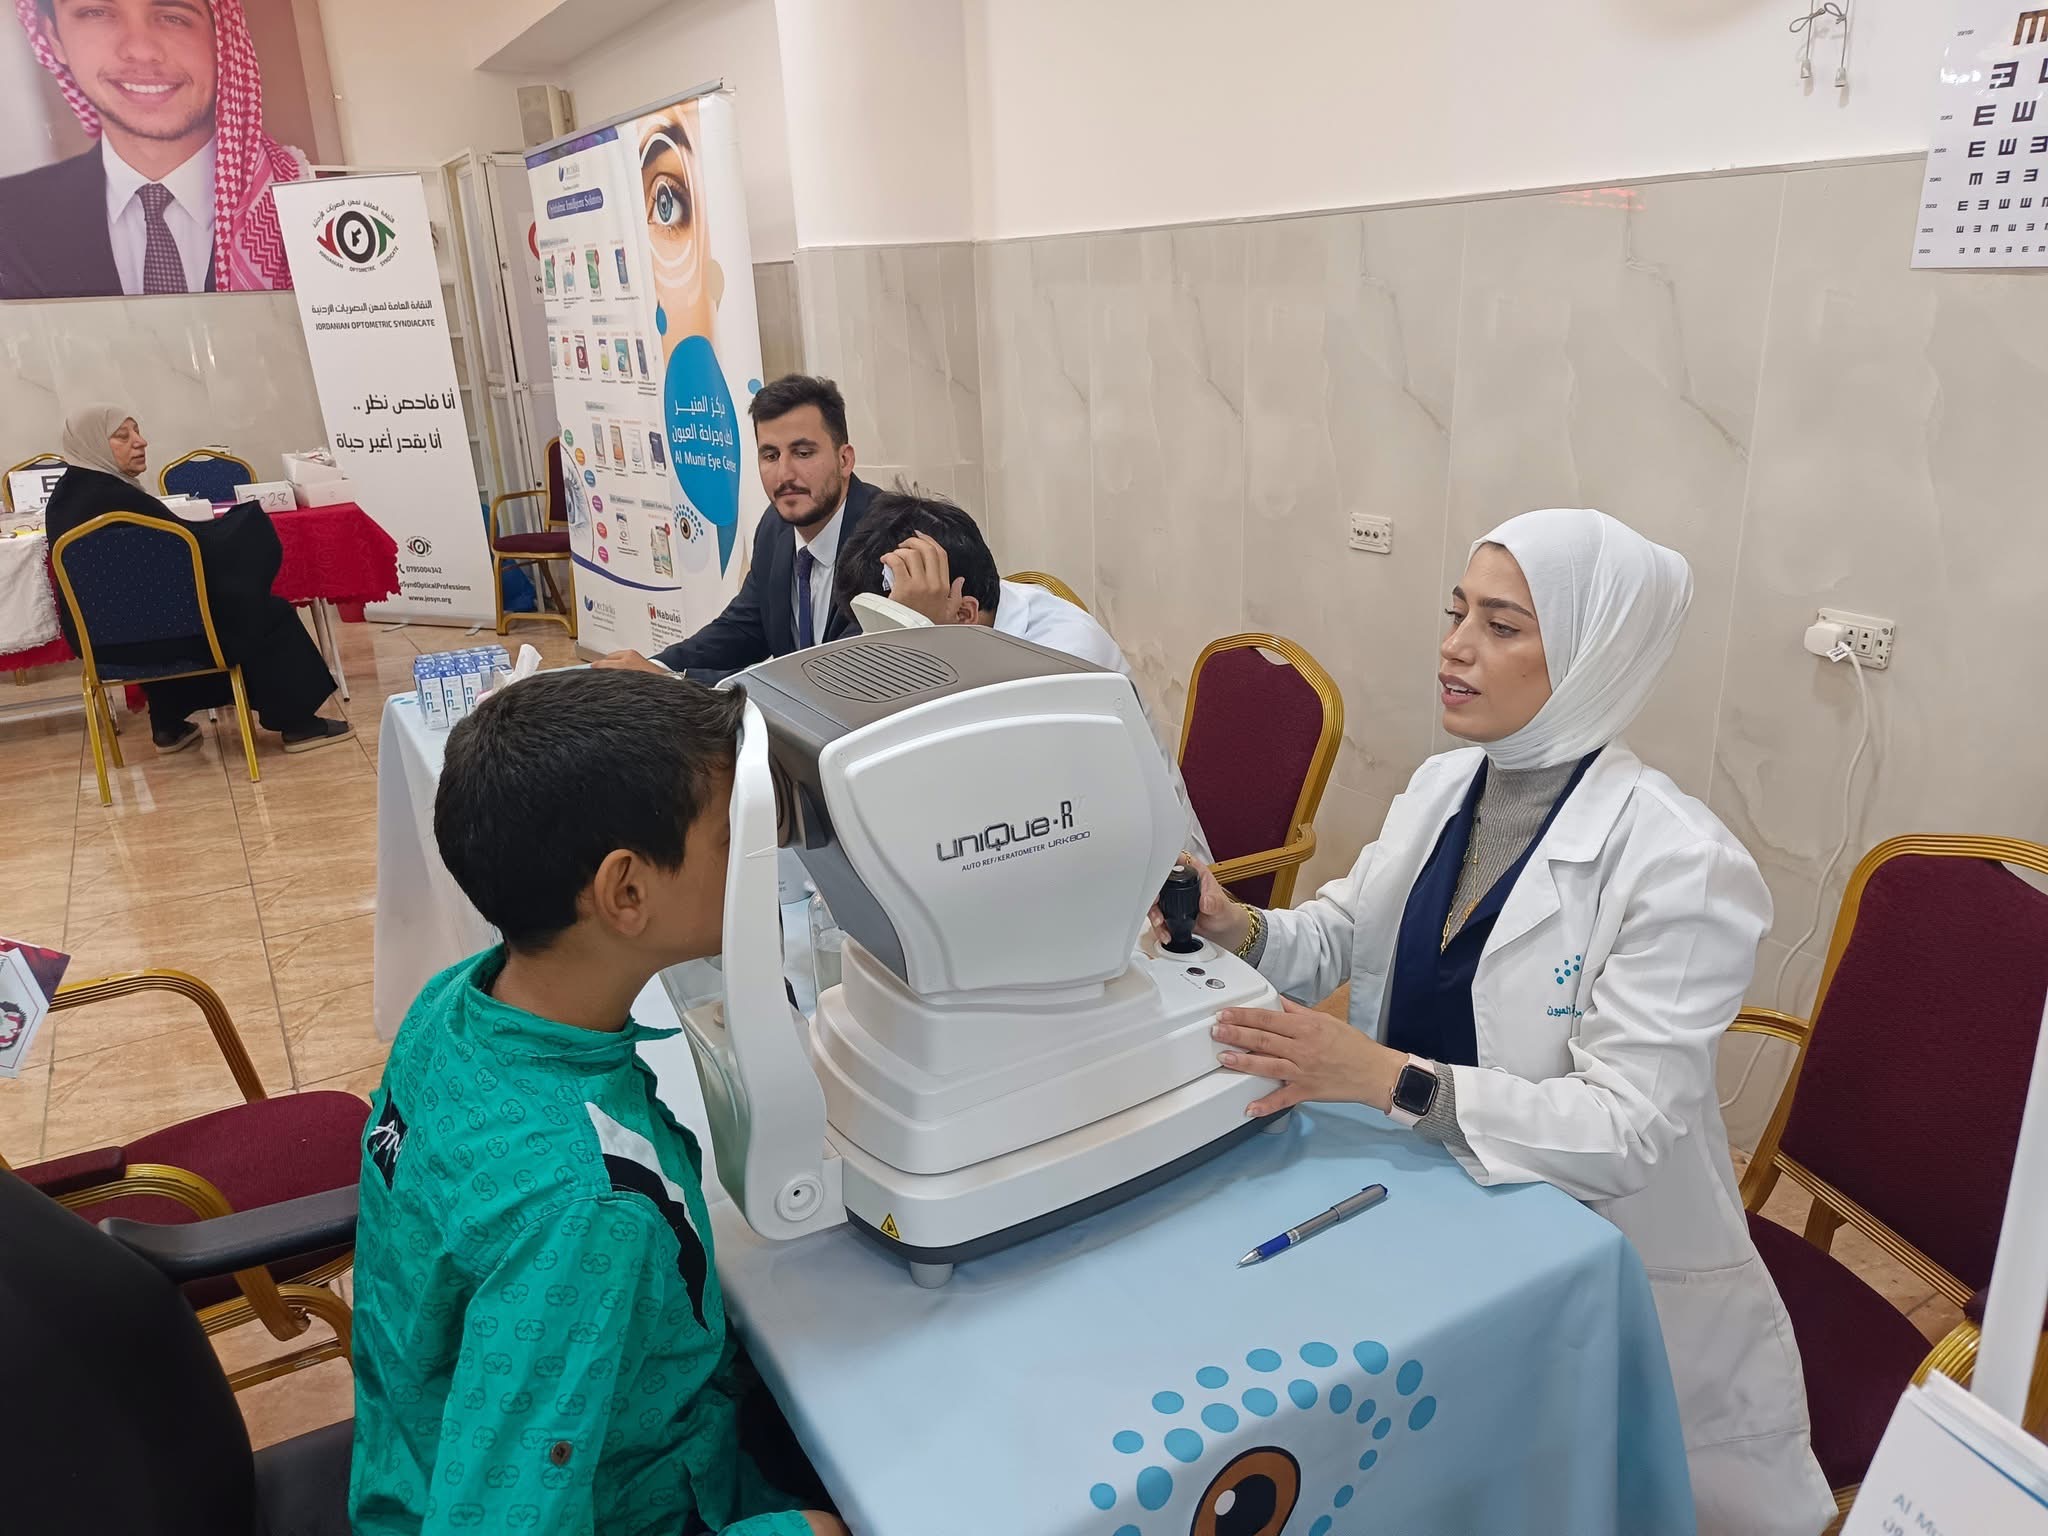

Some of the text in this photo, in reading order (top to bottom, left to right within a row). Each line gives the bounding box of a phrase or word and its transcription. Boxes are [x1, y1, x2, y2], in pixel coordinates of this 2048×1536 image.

[315, 322, 350, 331] JORDANIAN
[351, 321, 393, 329] OPTOMETRIC
[365, 393, 389, 415] نظر
[392, 393, 439, 415] فاحص
[443, 388, 456, 410] أنا
[336, 428, 442, 454] أنا بقدر أغير حياة
[672, 423, 697, 443] العيون
[675, 450, 683, 464] Al
[684, 451, 707, 466] Munir
[708, 453, 722, 472] Eye
[656, 608, 682, 624] Nabulsi
[961, 861, 981, 872] AUTO
[982, 844, 1046, 867] REF/KERATOMETER
